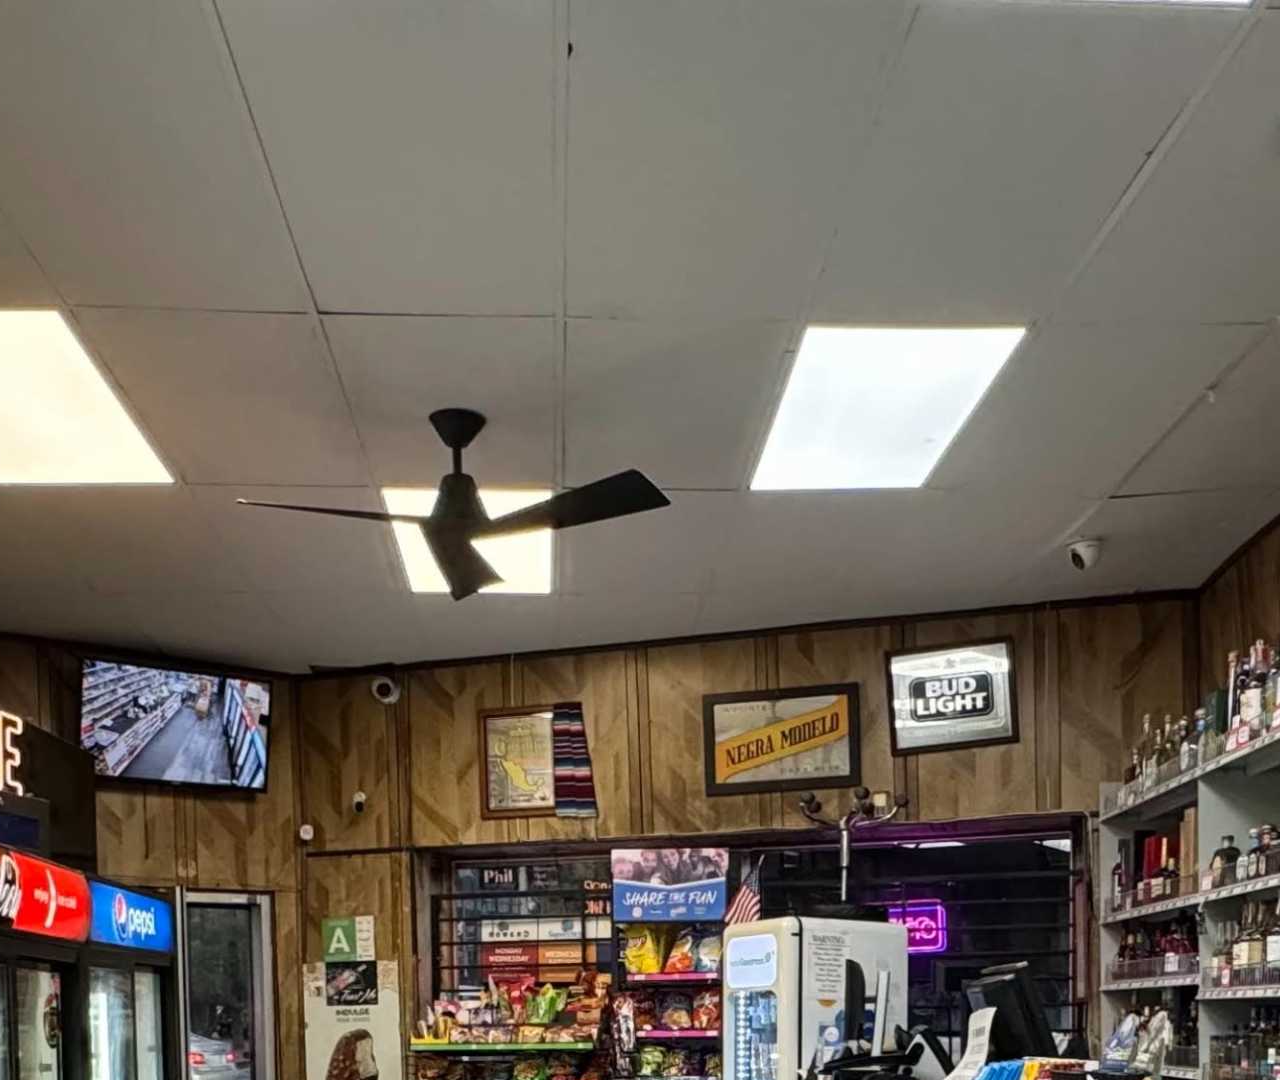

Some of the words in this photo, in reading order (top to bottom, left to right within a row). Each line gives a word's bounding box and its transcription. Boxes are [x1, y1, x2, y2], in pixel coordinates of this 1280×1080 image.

[925, 677, 976, 698] BUD
[916, 692, 987, 716] LIGHT
[726, 735, 775, 768] NEGRA
[780, 712, 839, 749] MODELO
[484, 868, 513, 883] Phil
[622, 890, 668, 907] SHARE
[689, 890, 717, 906] FUN
[128, 908, 156, 939] pepsi
[328, 927, 350, 954] A
[336, 1008, 369, 1017] INDULGE
